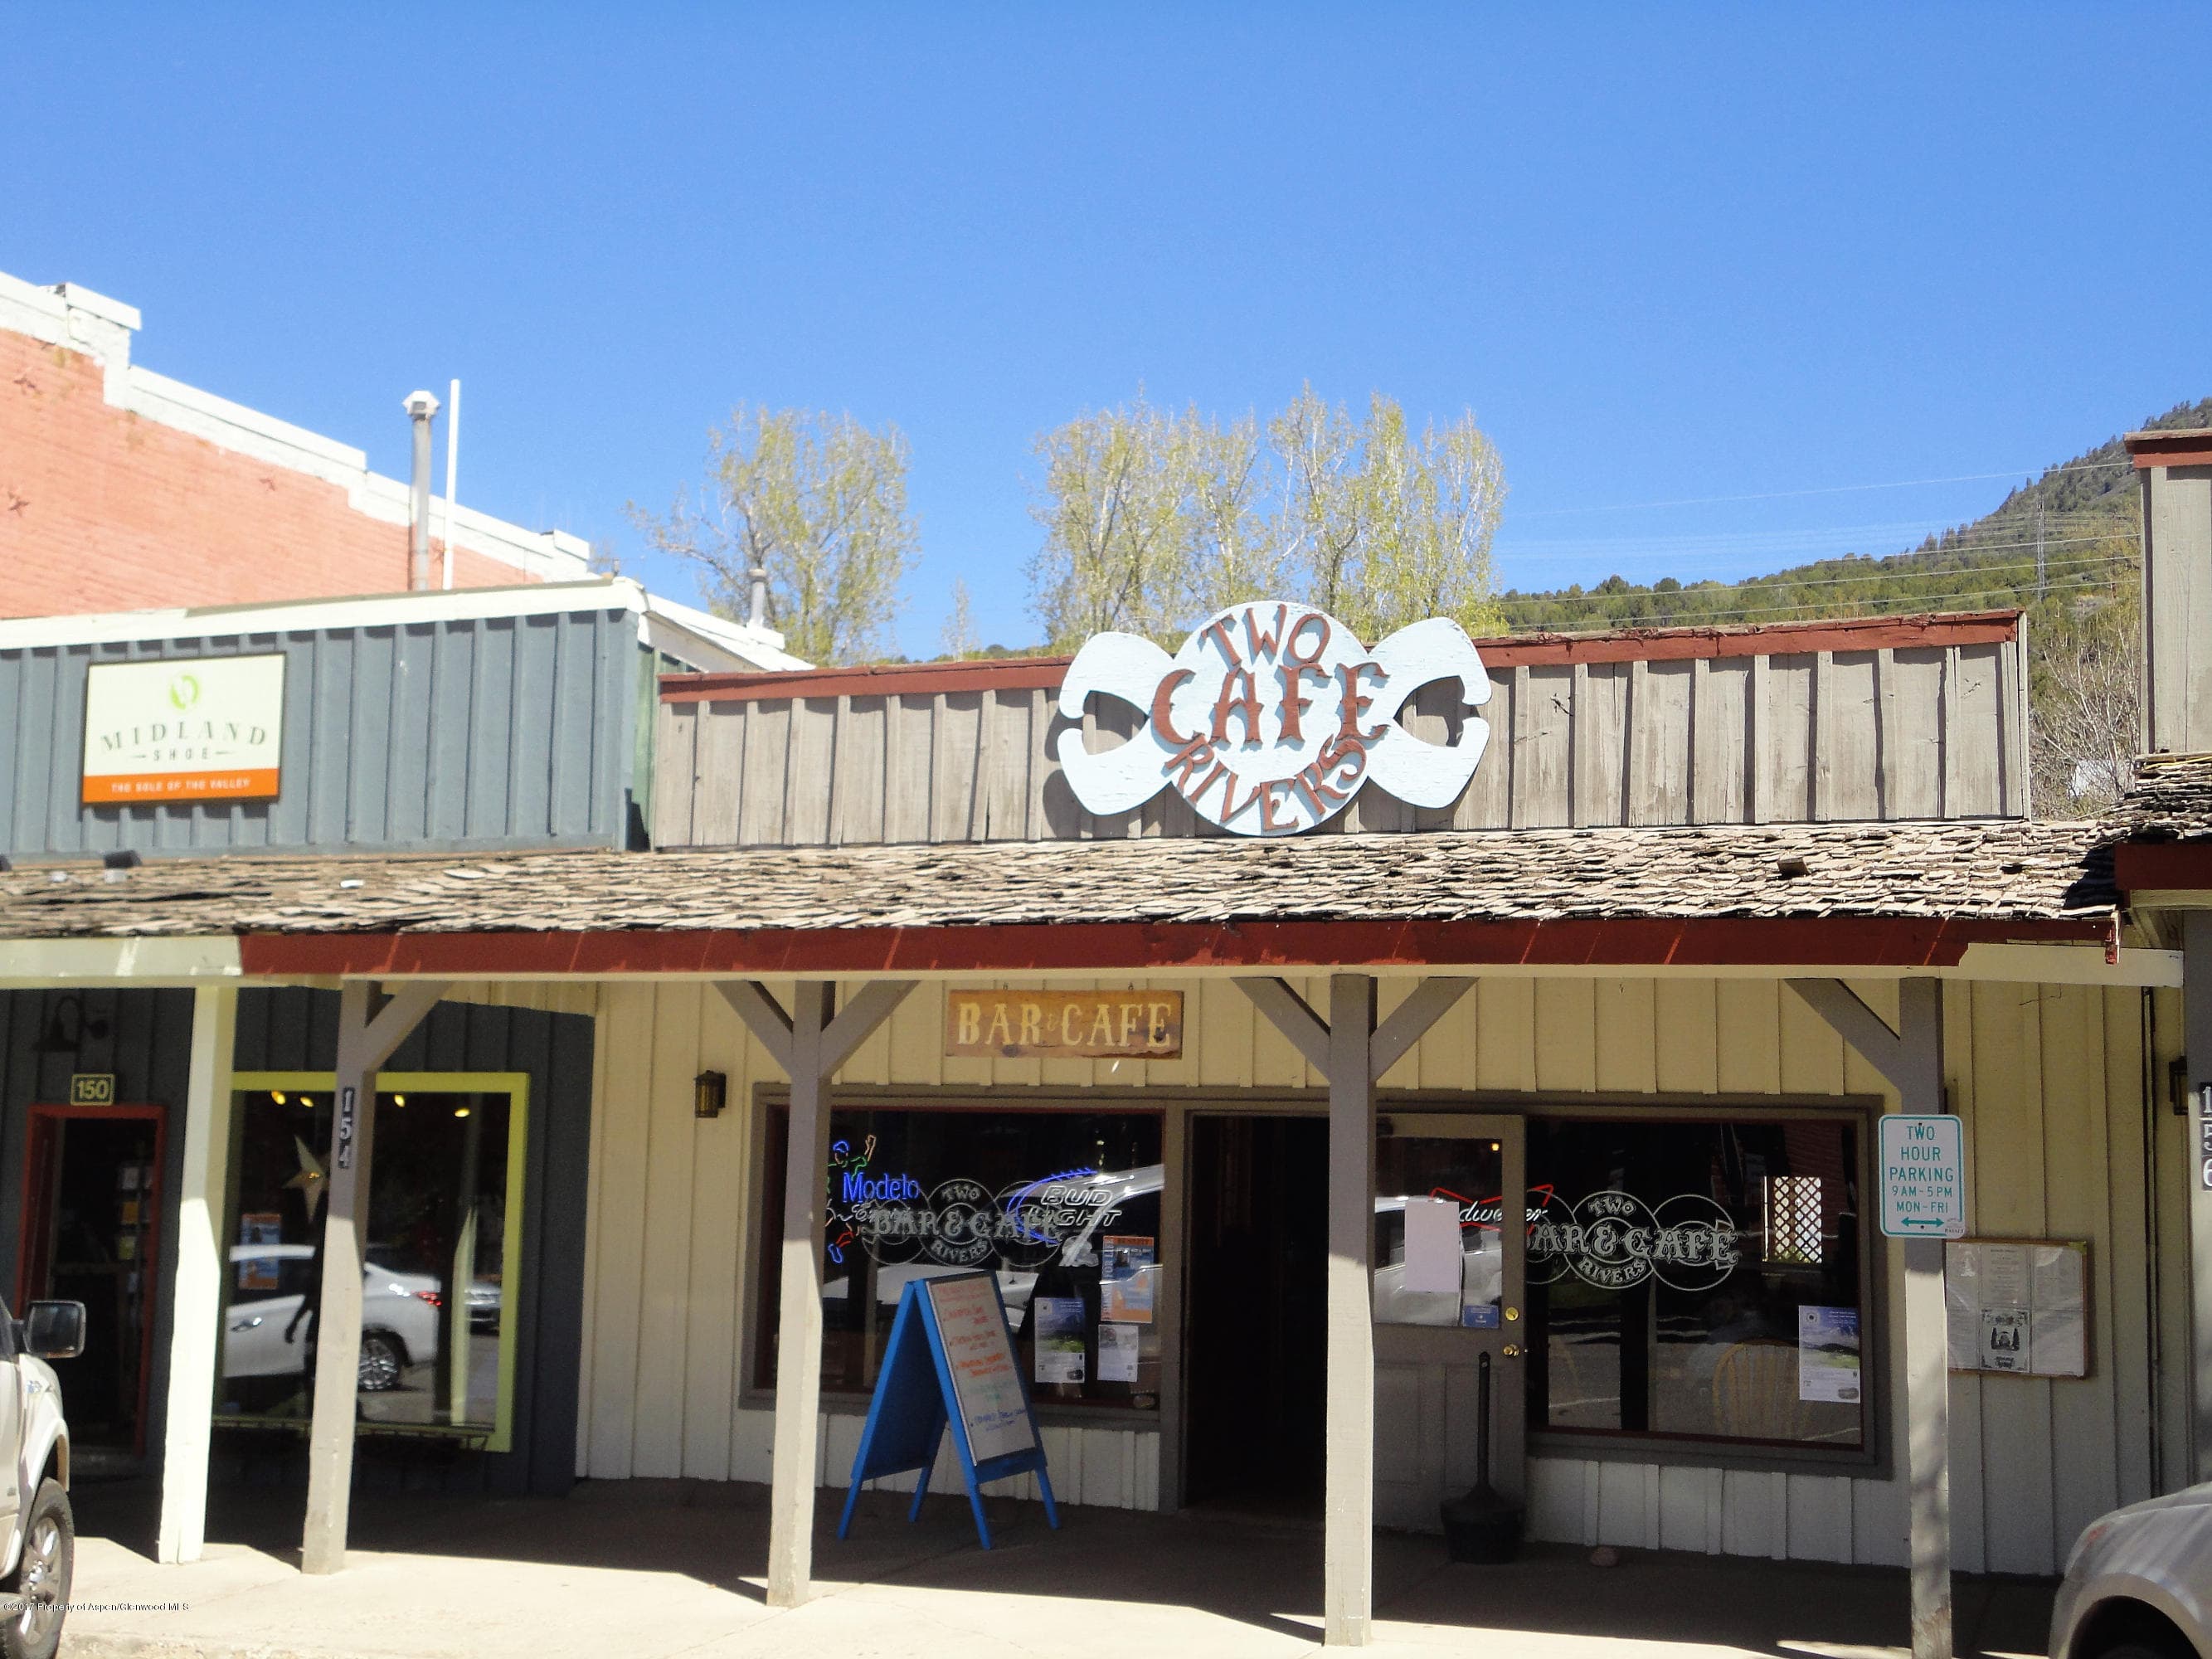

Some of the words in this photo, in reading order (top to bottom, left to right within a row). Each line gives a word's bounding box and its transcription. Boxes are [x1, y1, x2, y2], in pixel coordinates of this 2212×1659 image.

[1199, 604, 1332, 666] TWO
[1150, 662, 1390, 745] CAFE
[101, 721, 266, 751] MIDLAND
[153, 747, 209, 761] SHOE
[1165, 732, 1367, 831] RIVERS
[957, 1002, 1043, 1046] BAR
[1061, 1003, 1172, 1048] CAFE
[79, 1080, 109, 1100] 150
[338, 1087, 355, 1169] 154
[1906, 1126, 1936, 1141] TWO
[1900, 1146, 1941, 1161] HOUR
[842, 1171, 920, 1203] Modelo
[1889, 1167, 1954, 1182] PARKING
[941, 1183, 980, 1203] TWO
[1040, 1185, 1113, 1207] BUD
[1587, 1197, 1636, 1216] TWO
[931, 1238, 989, 1263] RIVERS
[1527, 1224, 1591, 1255] AR
[1591, 1223, 1618, 1257] &
[1619, 1228, 1740, 1265] CAFE
[1576, 1258, 1646, 1285] RIVERS
